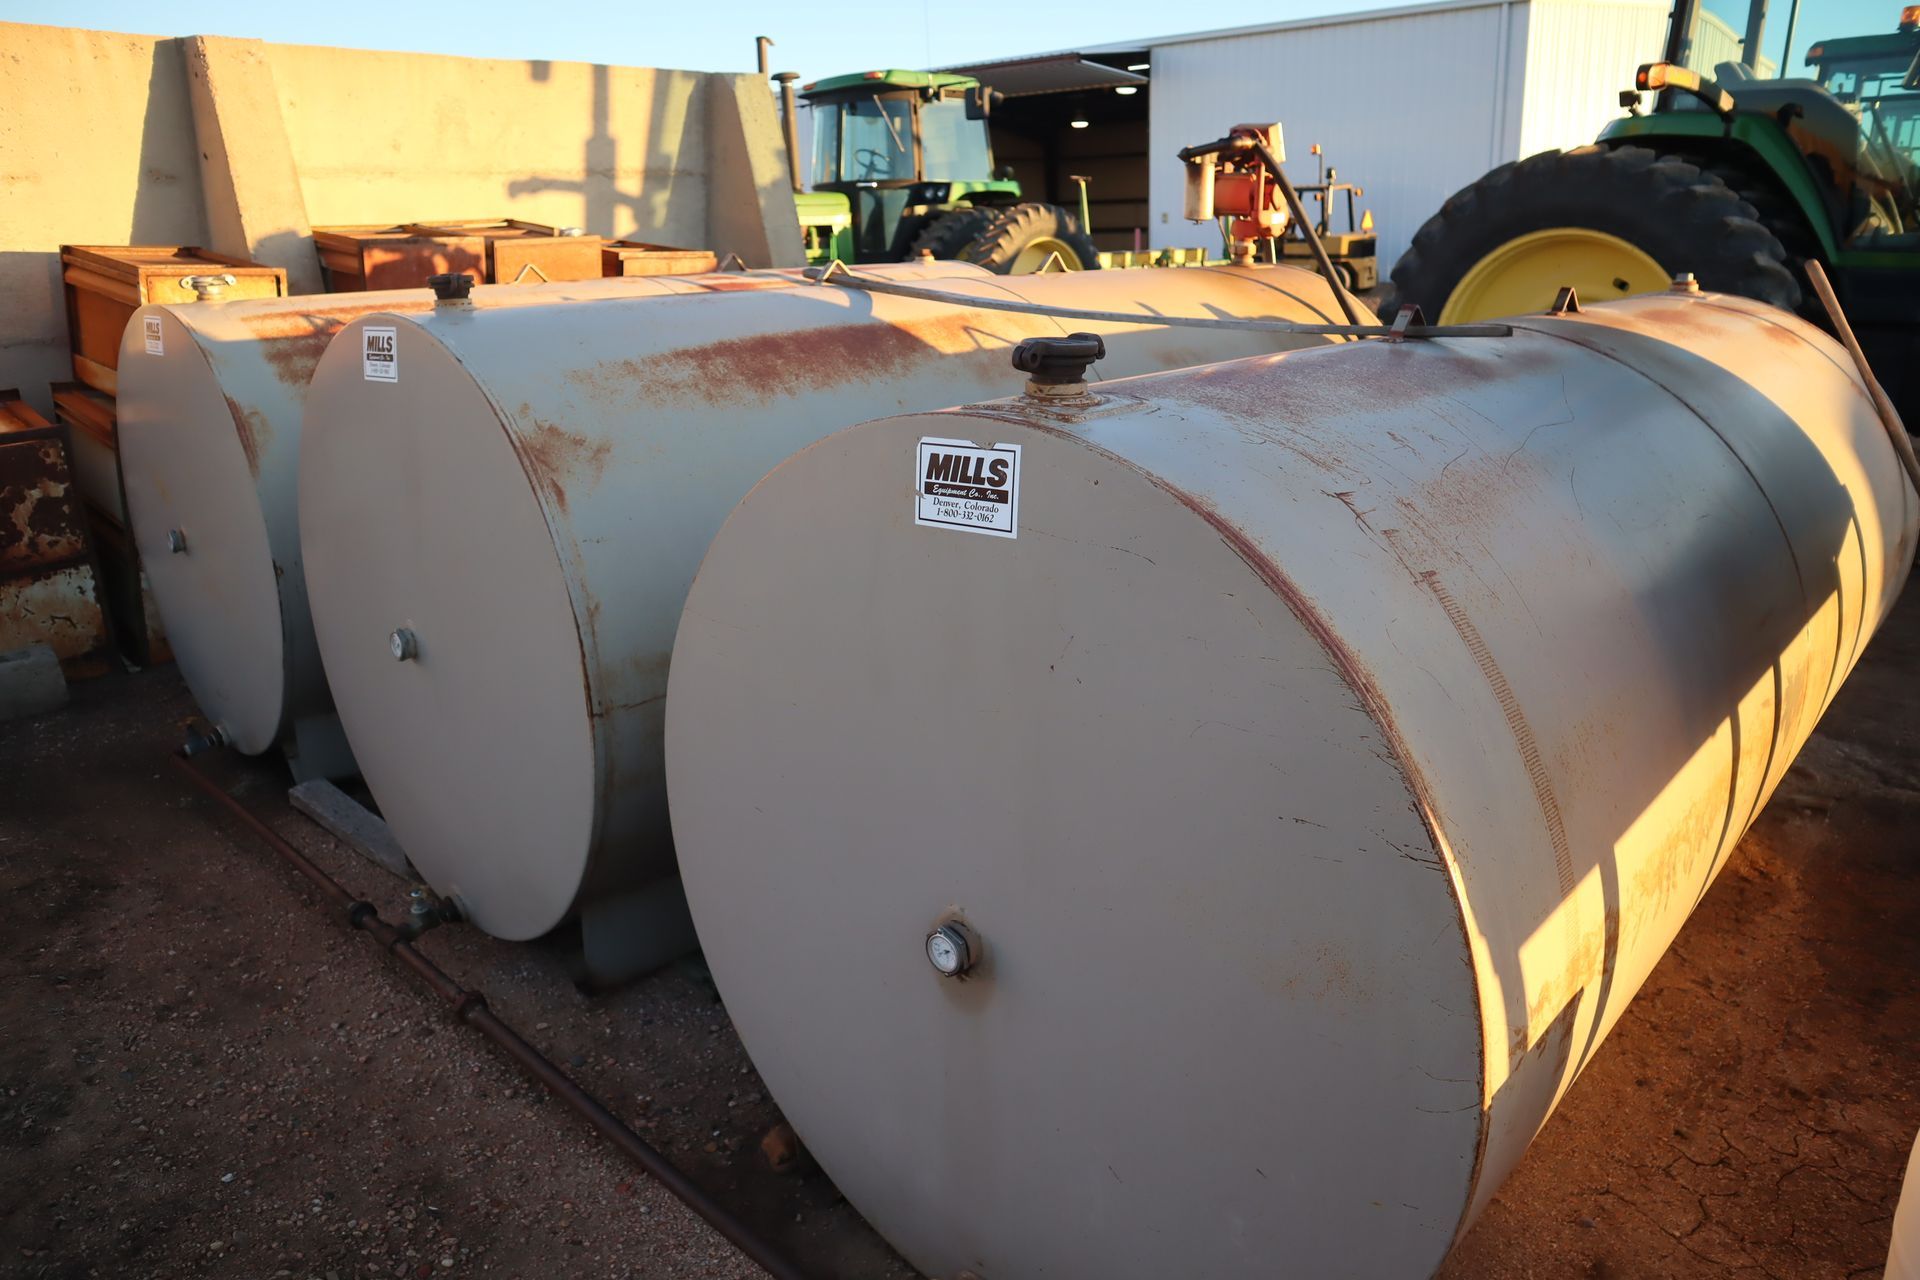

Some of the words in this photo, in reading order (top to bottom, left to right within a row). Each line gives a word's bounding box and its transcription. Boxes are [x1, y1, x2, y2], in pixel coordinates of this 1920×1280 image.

[366, 335, 393, 353] MILLS
[926, 453, 1009, 488] MILLS
[932, 484, 967, 495] Equipment
[986, 490, 999, 500] Inc.
[933, 497, 961, 509] Denver,
[964, 501, 999, 513] Colorado
[937, 508, 995, 523] 1-800-332-0162
